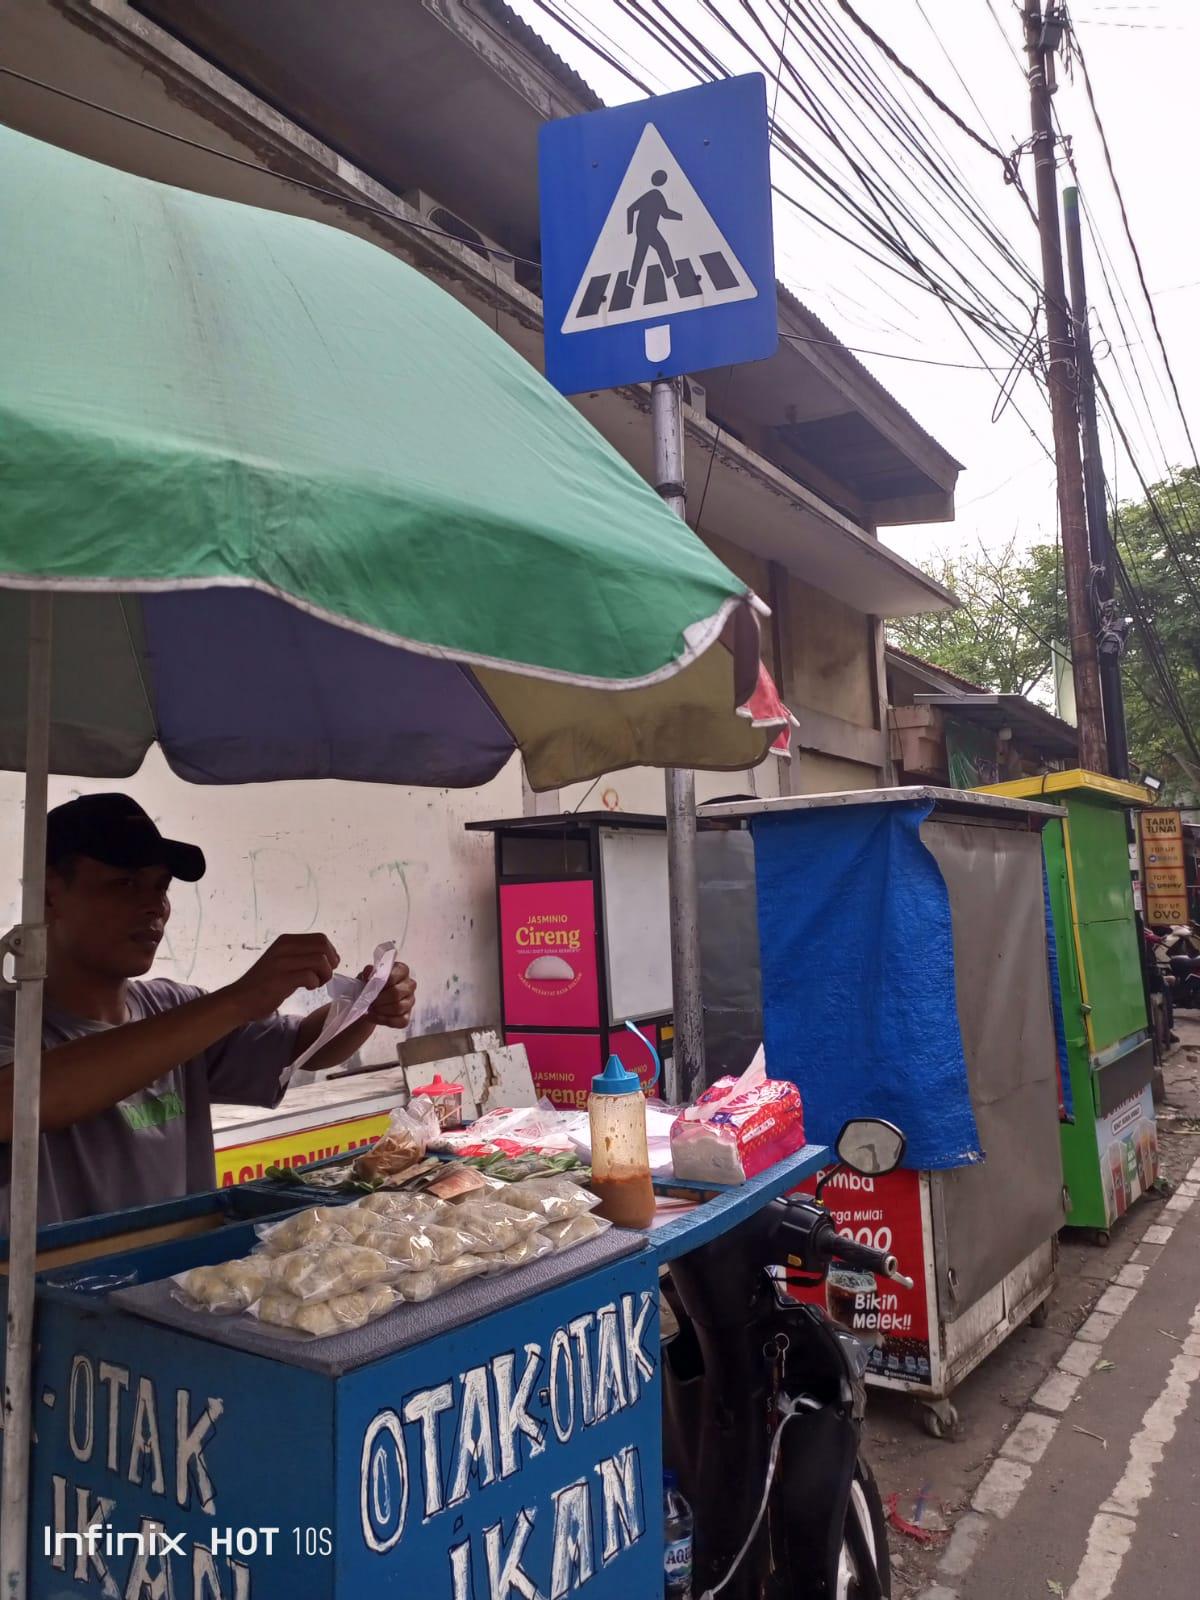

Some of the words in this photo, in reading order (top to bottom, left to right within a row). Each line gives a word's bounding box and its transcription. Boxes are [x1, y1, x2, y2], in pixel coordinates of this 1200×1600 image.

[1145, 817, 1175, 825] TARIK
[1146, 825, 1177, 833] TUNAI
[527, 914, 568, 924] JASMINIO
[1153, 910, 1181, 919] OVO
[516, 926, 580, 949] Cireng
[533, 1072, 575, 1082] JASMINIO
[536, 1083, 588, 1109] ireng
[854, 1209, 883, 1221] Mulai
[855, 1293, 898, 1311] Bikin
[853, 1312, 912, 1331] Melek!!
